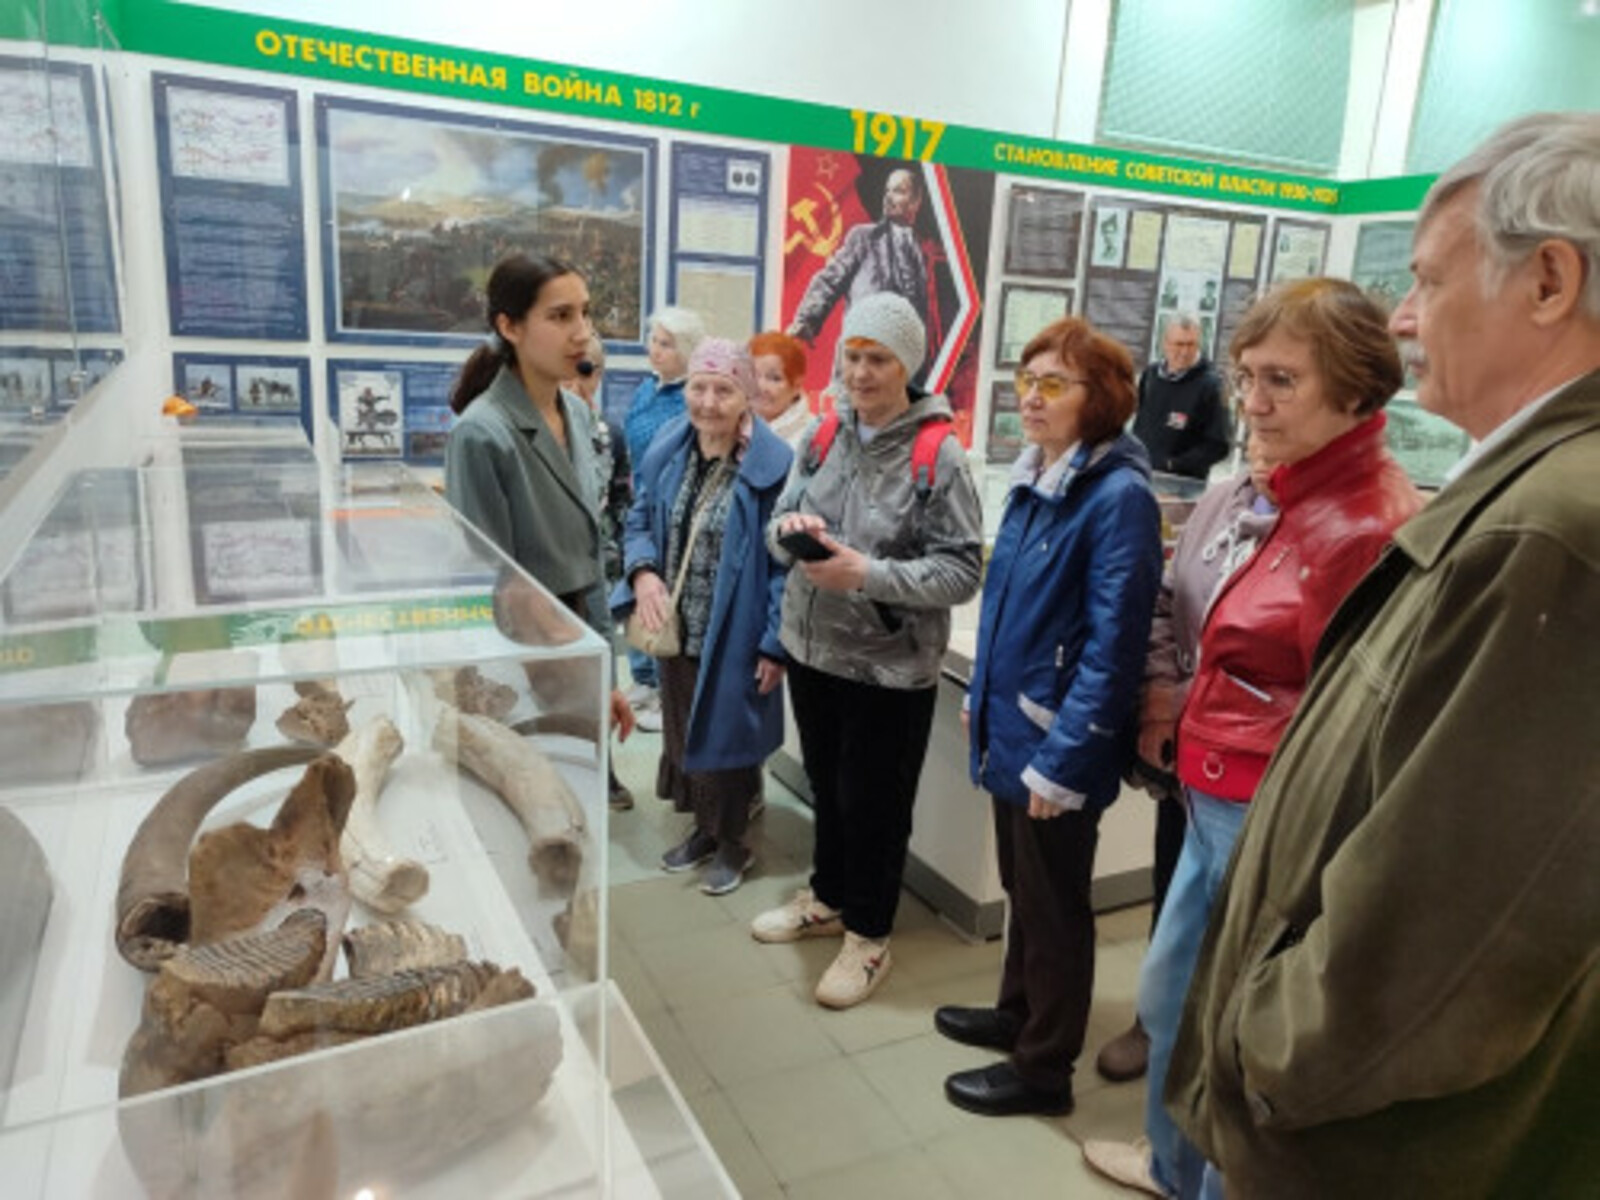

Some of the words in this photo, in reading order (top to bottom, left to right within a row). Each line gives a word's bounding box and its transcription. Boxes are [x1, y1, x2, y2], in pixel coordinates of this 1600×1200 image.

[255, 30, 507, 90] ОТЕЧЕСТВЕННАЯ
[524, 71, 623, 105] ВОЙНА
[635, 89, 681, 116] 1812
[850, 109, 946, 162] 1917
[994, 143, 1119, 176] СТАНОВЛЕНИЕ
[1125, 161, 1215, 188] СОВЕТСКОЙ
[1219, 174, 1278, 196] ВЛАСТИ
